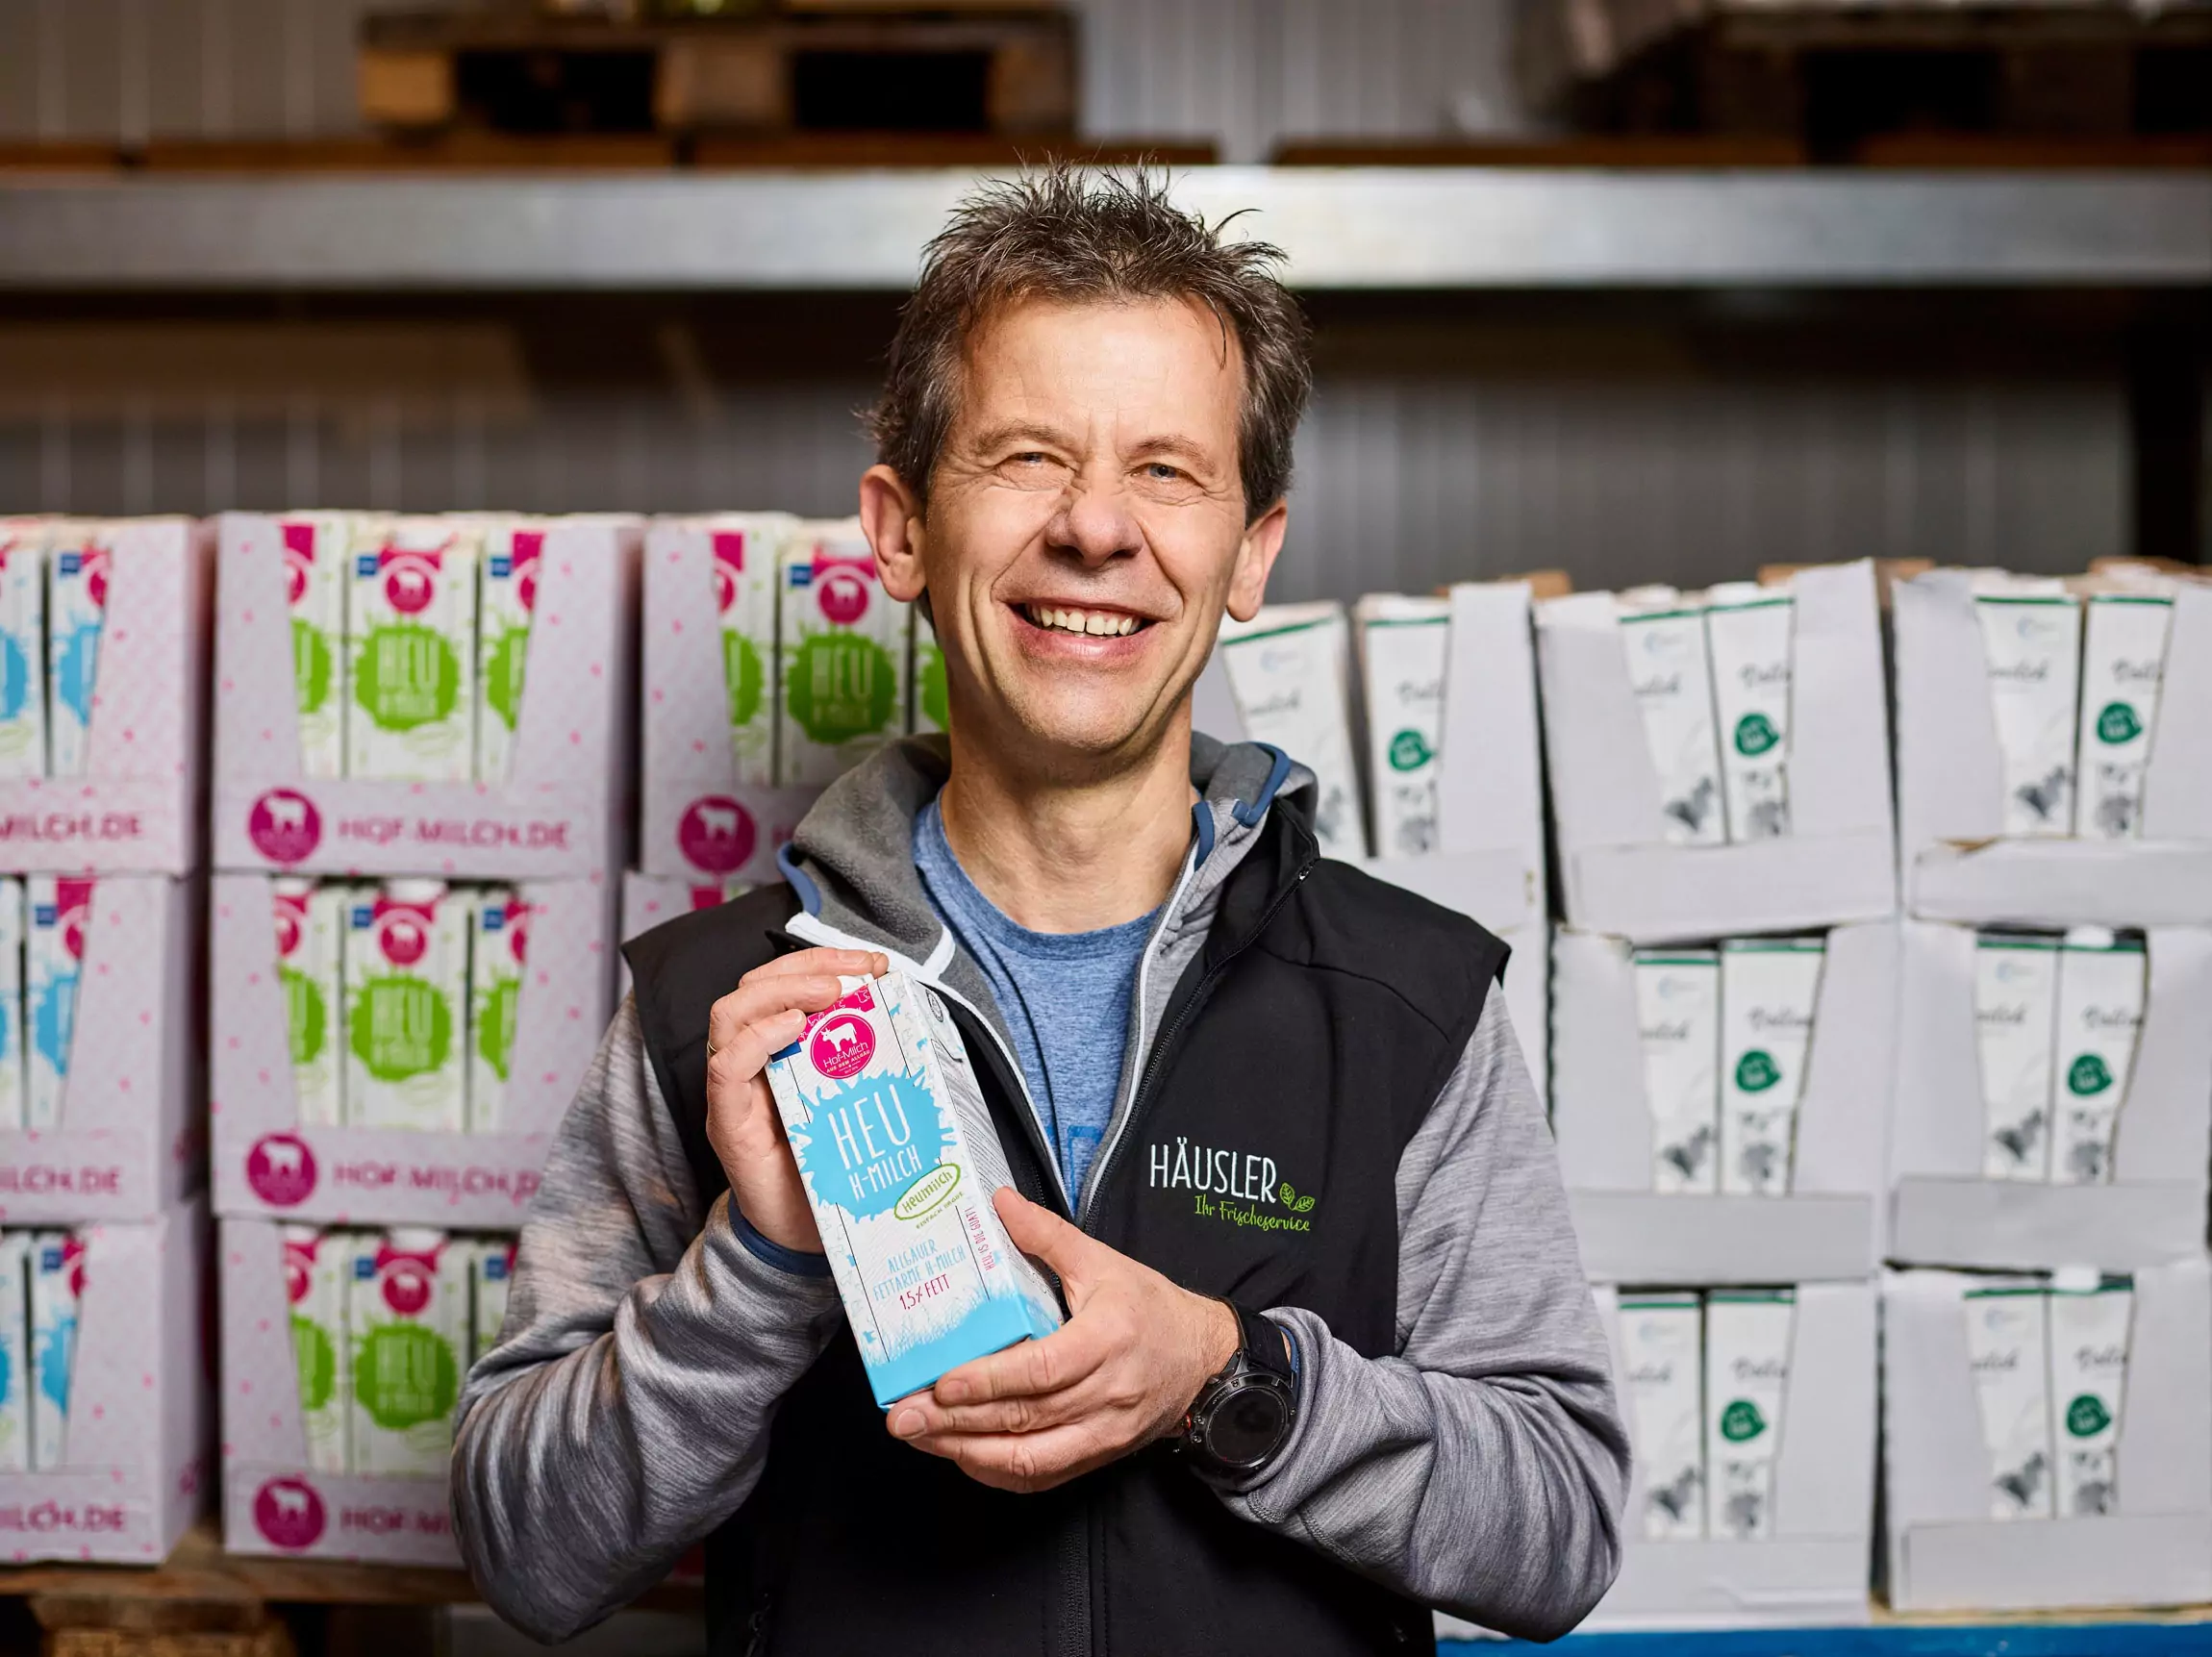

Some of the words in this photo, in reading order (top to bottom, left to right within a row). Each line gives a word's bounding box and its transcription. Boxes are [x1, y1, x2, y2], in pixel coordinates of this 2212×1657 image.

[823, 1042, 868, 1067] Hof-Milch
[827, 1084, 911, 1170] HEU
[848, 1143, 923, 1202] H-MILCH
[901, 1170, 953, 1214] Heumilch
[1149, 1136, 1277, 1204] HÄUSLER
[1194, 1193, 1216, 1217] Ihr
[1219, 1199, 1311, 1232] Frischeservice
[872, 1266, 922, 1301] FETTARME
[924, 1243, 967, 1276] H-MILCH
[899, 1286, 923, 1310] 1,5%
[924, 1273, 950, 1298] FETT
